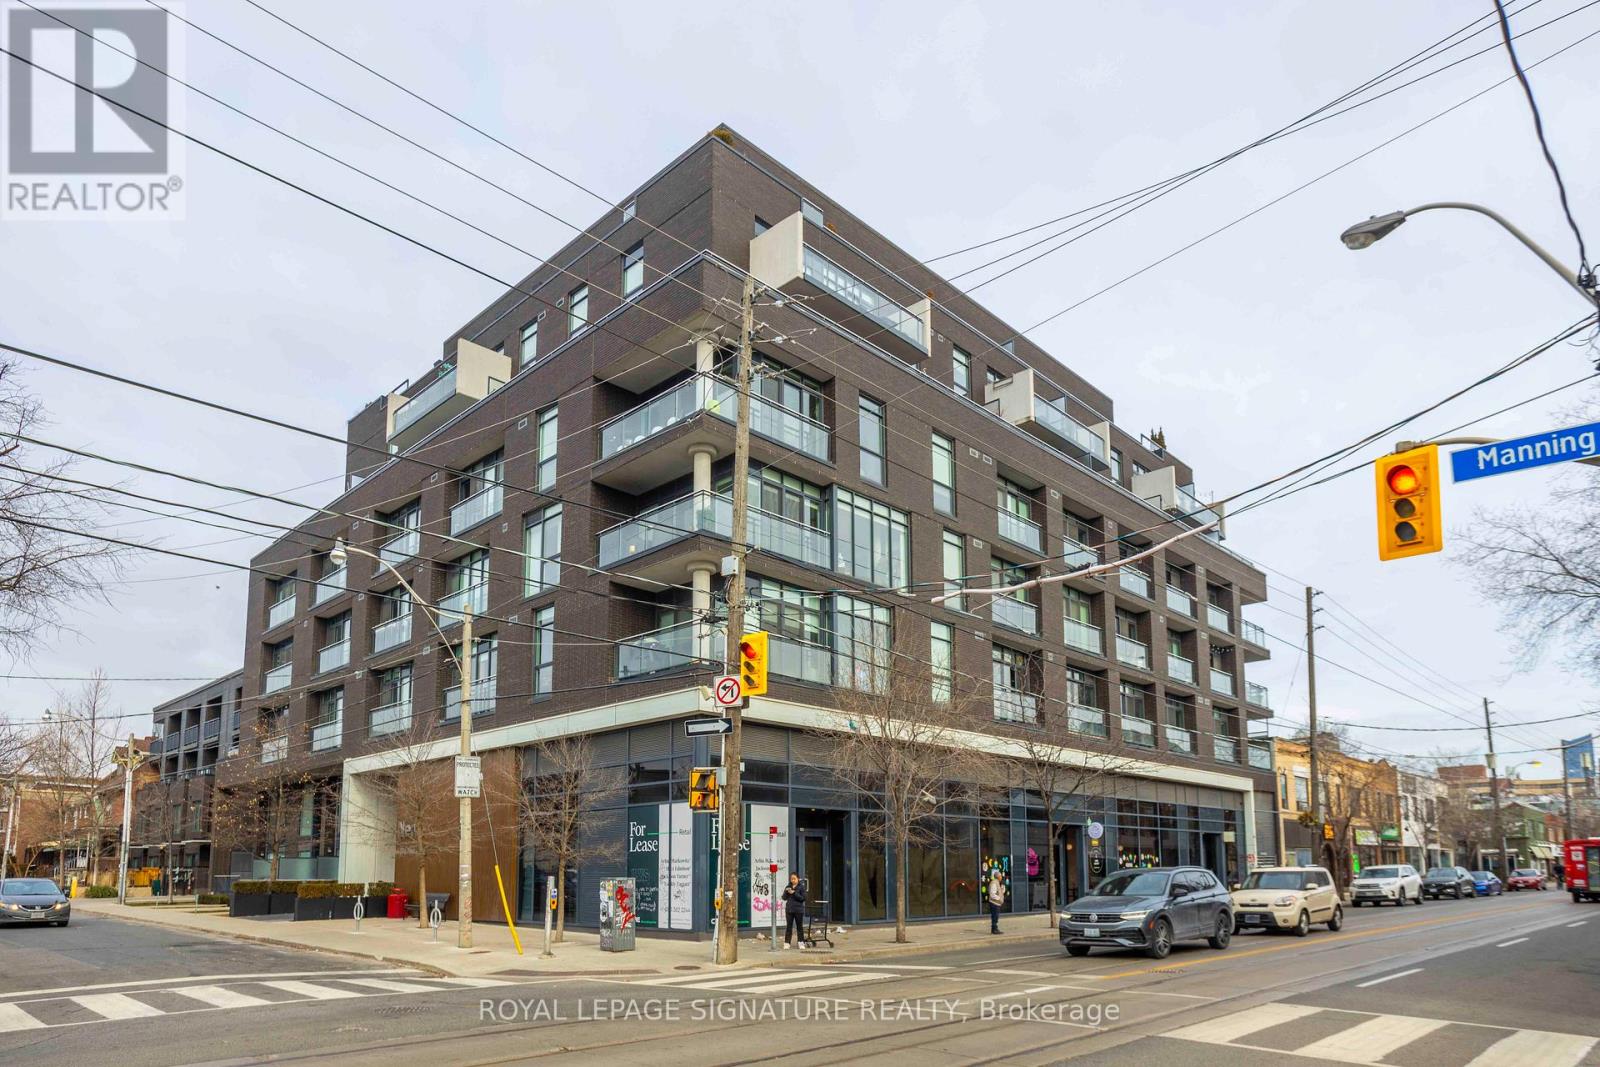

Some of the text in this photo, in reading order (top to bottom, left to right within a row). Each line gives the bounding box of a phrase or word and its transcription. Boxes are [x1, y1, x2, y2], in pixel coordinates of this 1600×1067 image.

[1477, 431, 1596, 470] Manning
[629, 821, 646, 837] For
[629, 837, 658, 852] Lease
